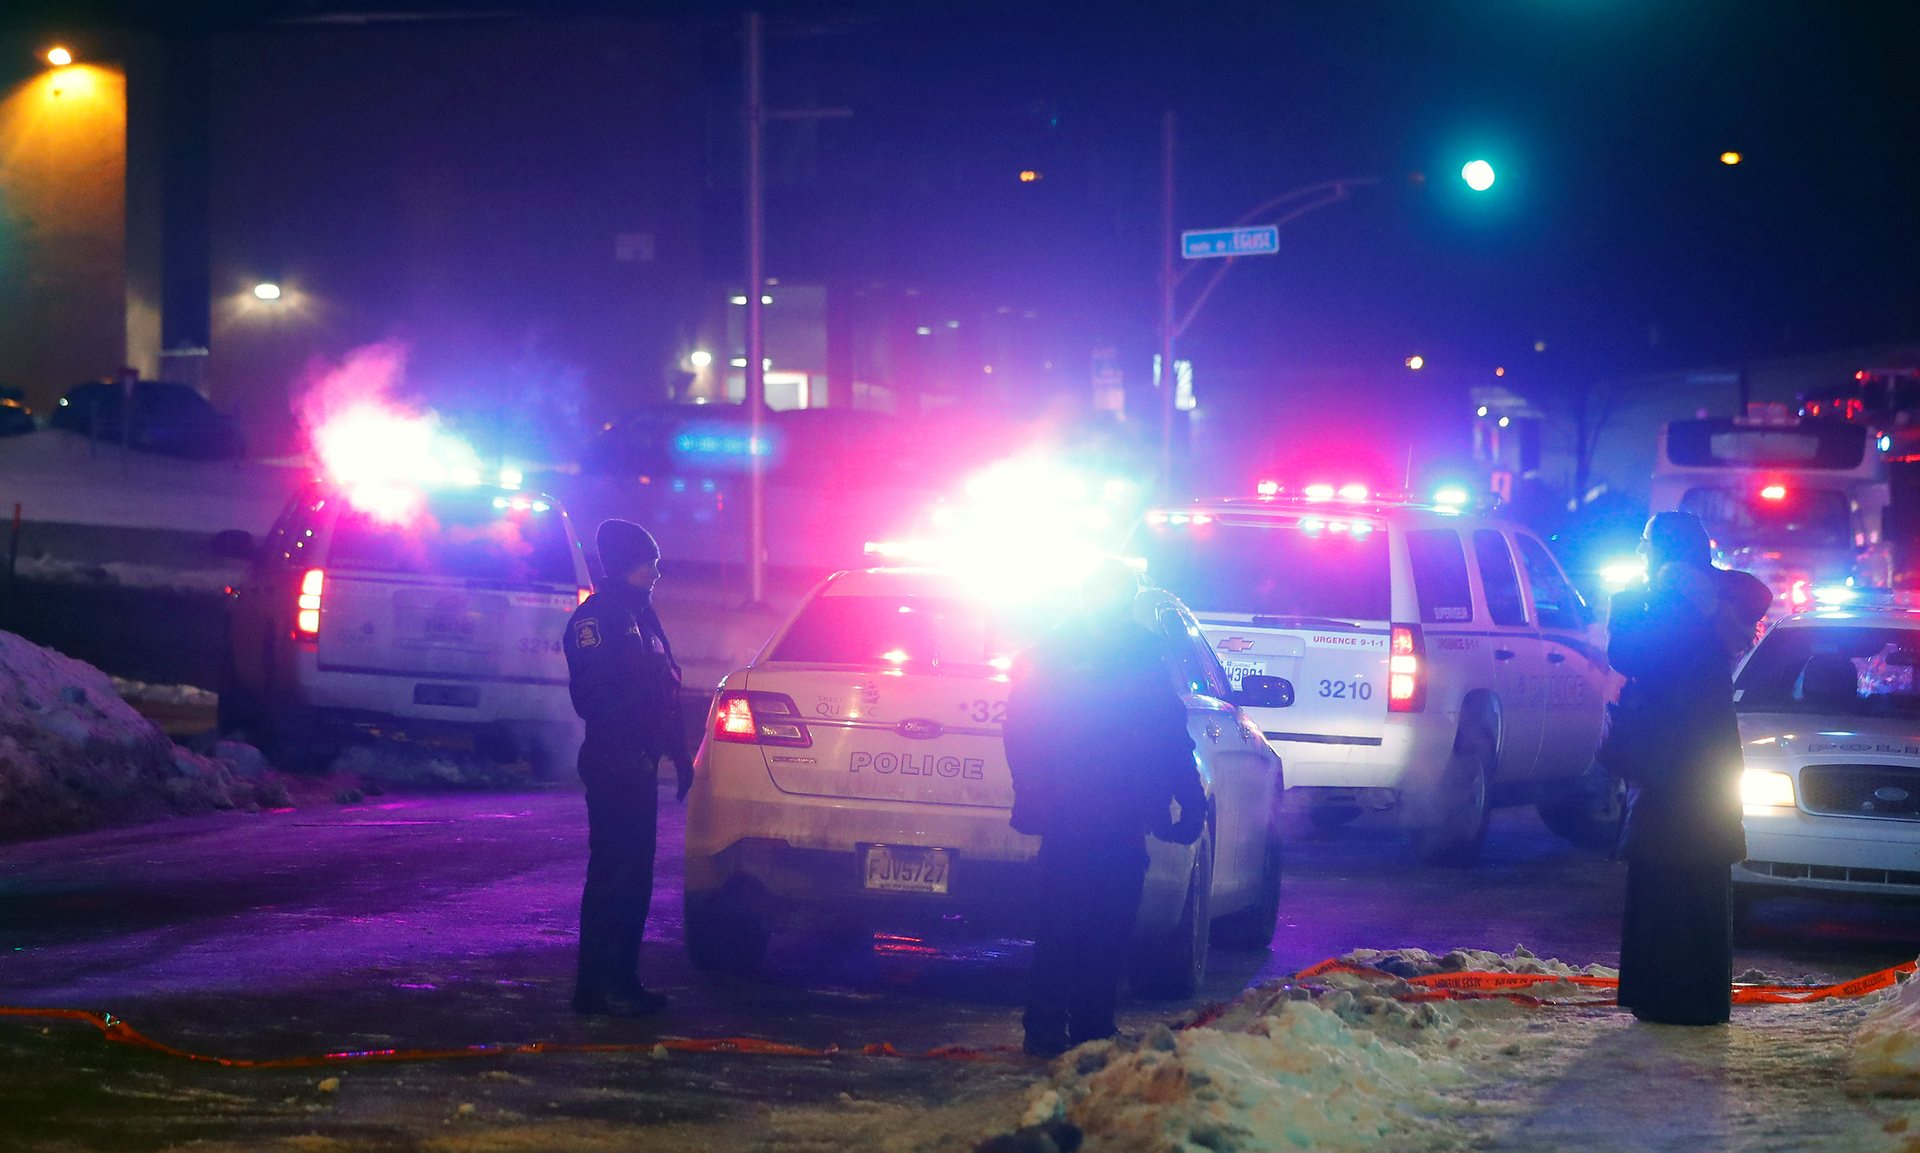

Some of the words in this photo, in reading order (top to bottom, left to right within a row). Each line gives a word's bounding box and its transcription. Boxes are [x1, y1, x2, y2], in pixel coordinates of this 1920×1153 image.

[1313, 635, 1357, 645] URGENCE
[1360, 638, 1384, 647] 9-1-1
[1318, 679, 1373, 701] 3210
[849, 751, 985, 779] POLICE
